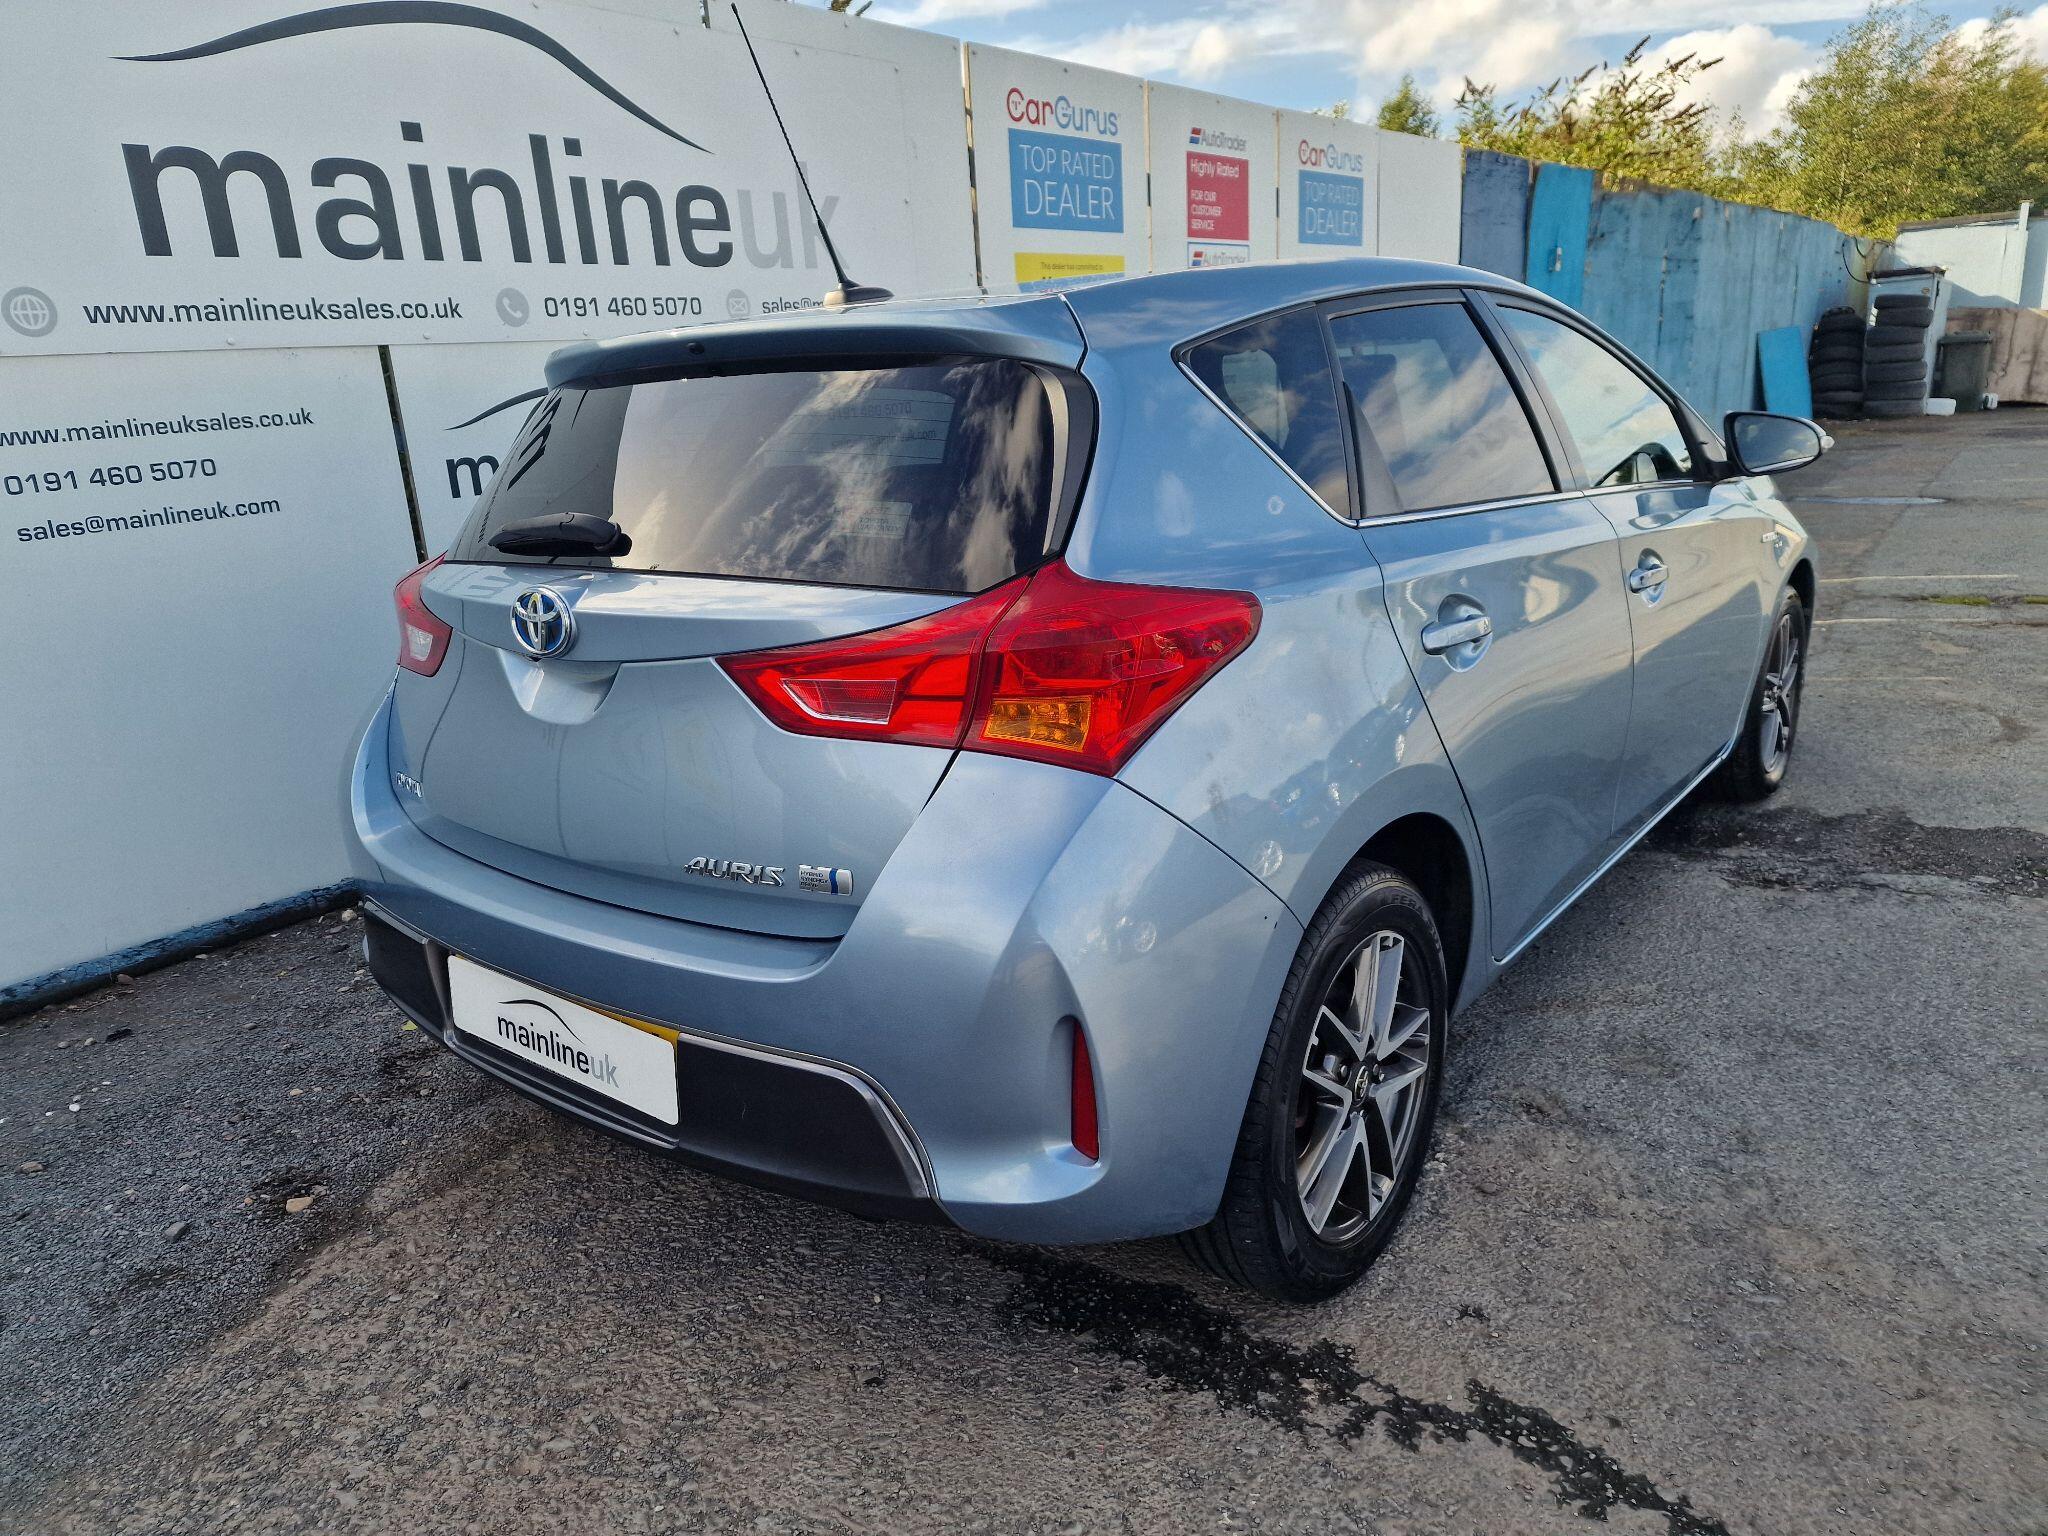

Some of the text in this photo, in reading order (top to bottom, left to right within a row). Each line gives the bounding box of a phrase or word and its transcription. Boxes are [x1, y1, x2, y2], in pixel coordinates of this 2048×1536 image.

[1006, 87, 1119, 136] CarGurus
[1019, 144, 1115, 179] TOP RATED
[1190, 158, 1240, 178] Highly Rated
[1298, 139, 1363, 172] CarGurus
[121, 121, 849, 269] mainlineuk
[1024, 179, 1115, 220] DEALER
[1305, 181, 1360, 206] TOP RATED
[1305, 206, 1360, 237] DEALER
[82, 297, 463, 324] www.mainlineuksales.co.uk
[544, 297, 702, 318] 0191 460 5070
[0, 407, 314, 447] www.mainlineuksales.co.uk
[3, 458, 217, 496] 0191 460 5070
[16, 498, 281, 542] sales@mainlineuk.com
[683, 856, 785, 888] AURIS
[497, 1015, 620, 1089] mainlineuk
